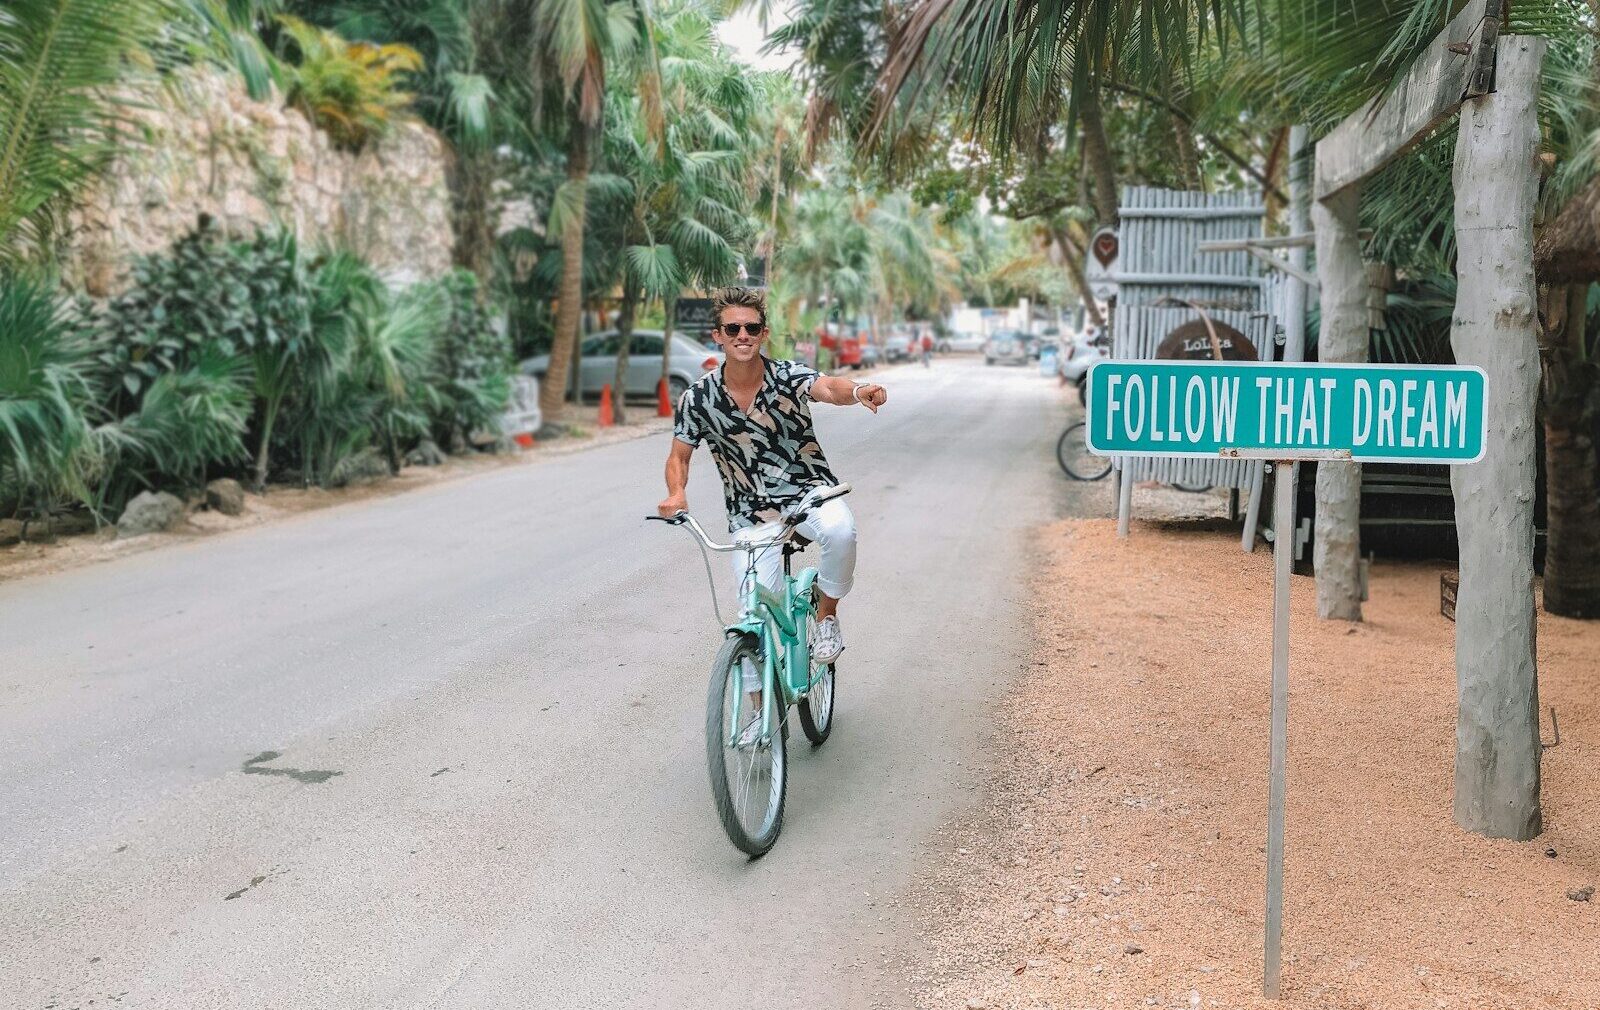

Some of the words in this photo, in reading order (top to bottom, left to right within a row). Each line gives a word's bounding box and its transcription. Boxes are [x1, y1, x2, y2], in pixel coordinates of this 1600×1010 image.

[1183, 337, 1233, 352] LoLta
[1106, 374, 1240, 443] FOLLOW
[1255, 377, 1337, 446] THAT
[1353, 378, 1468, 449] DREAM
